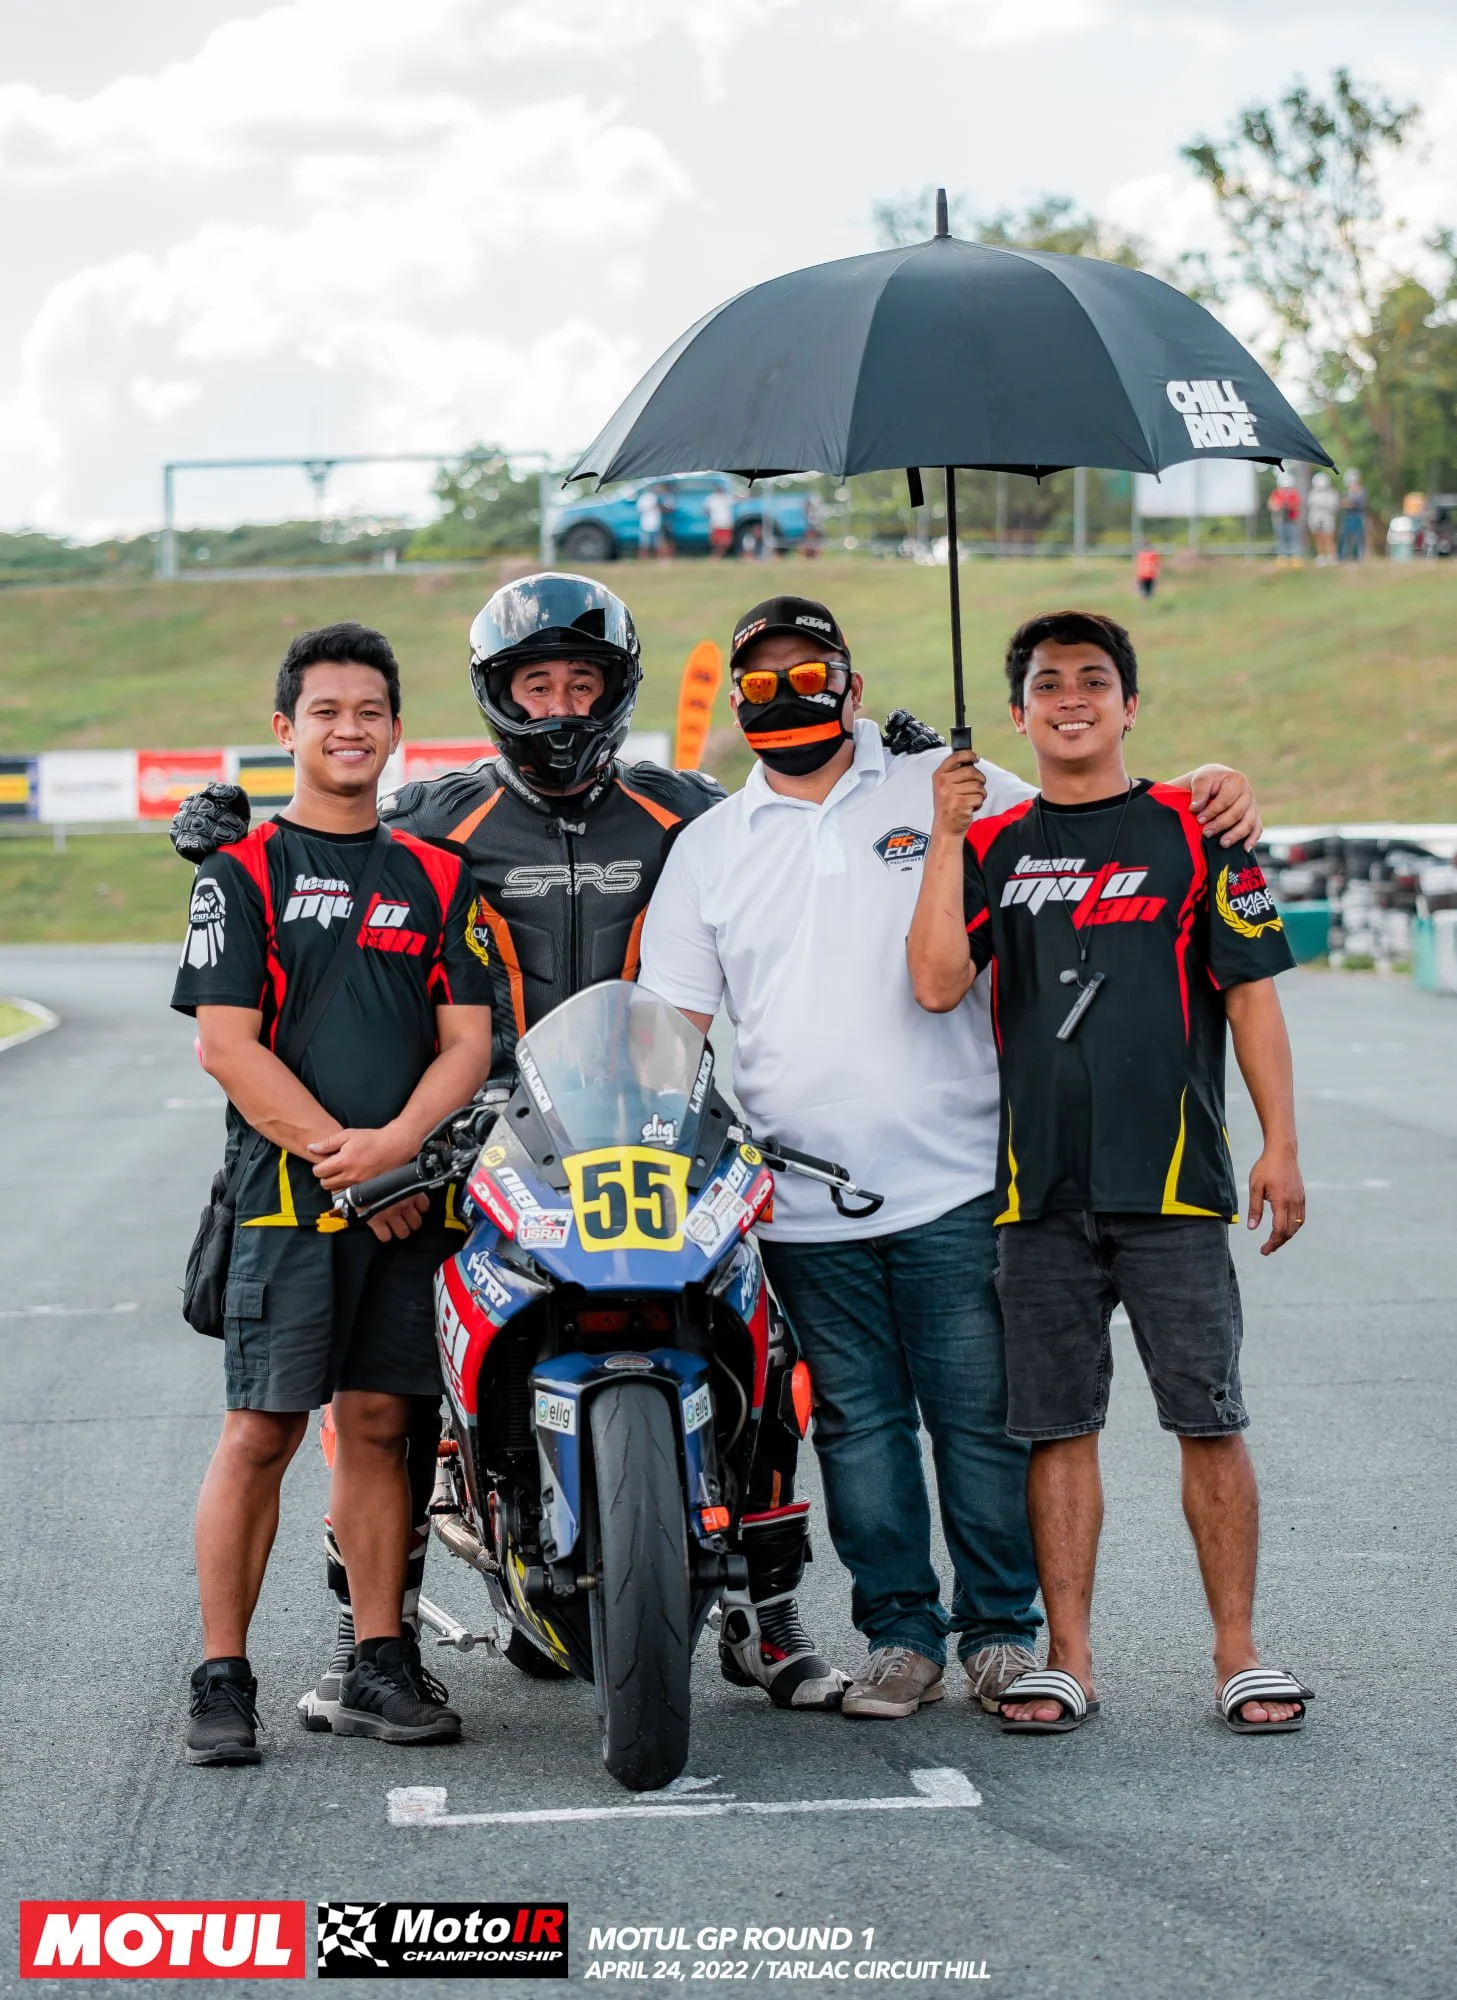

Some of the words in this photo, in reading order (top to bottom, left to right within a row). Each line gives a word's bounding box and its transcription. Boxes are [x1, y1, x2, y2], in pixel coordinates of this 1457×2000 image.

[1166, 380, 1248, 413] CHILL
[1182, 413, 1260, 448] RIDE
[795, 616, 831, 632] KTM
[884, 843, 926, 859] CUP
[887, 835, 916, 849] RC
[1014, 855, 1086, 876] team
[641, 1113, 678, 1146] elig
[582, 1161, 678, 1240] 55
[521, 1228, 564, 1241] USRA
[550, 1402, 570, 1429] elig
[695, 1392, 708, 1419] elig
